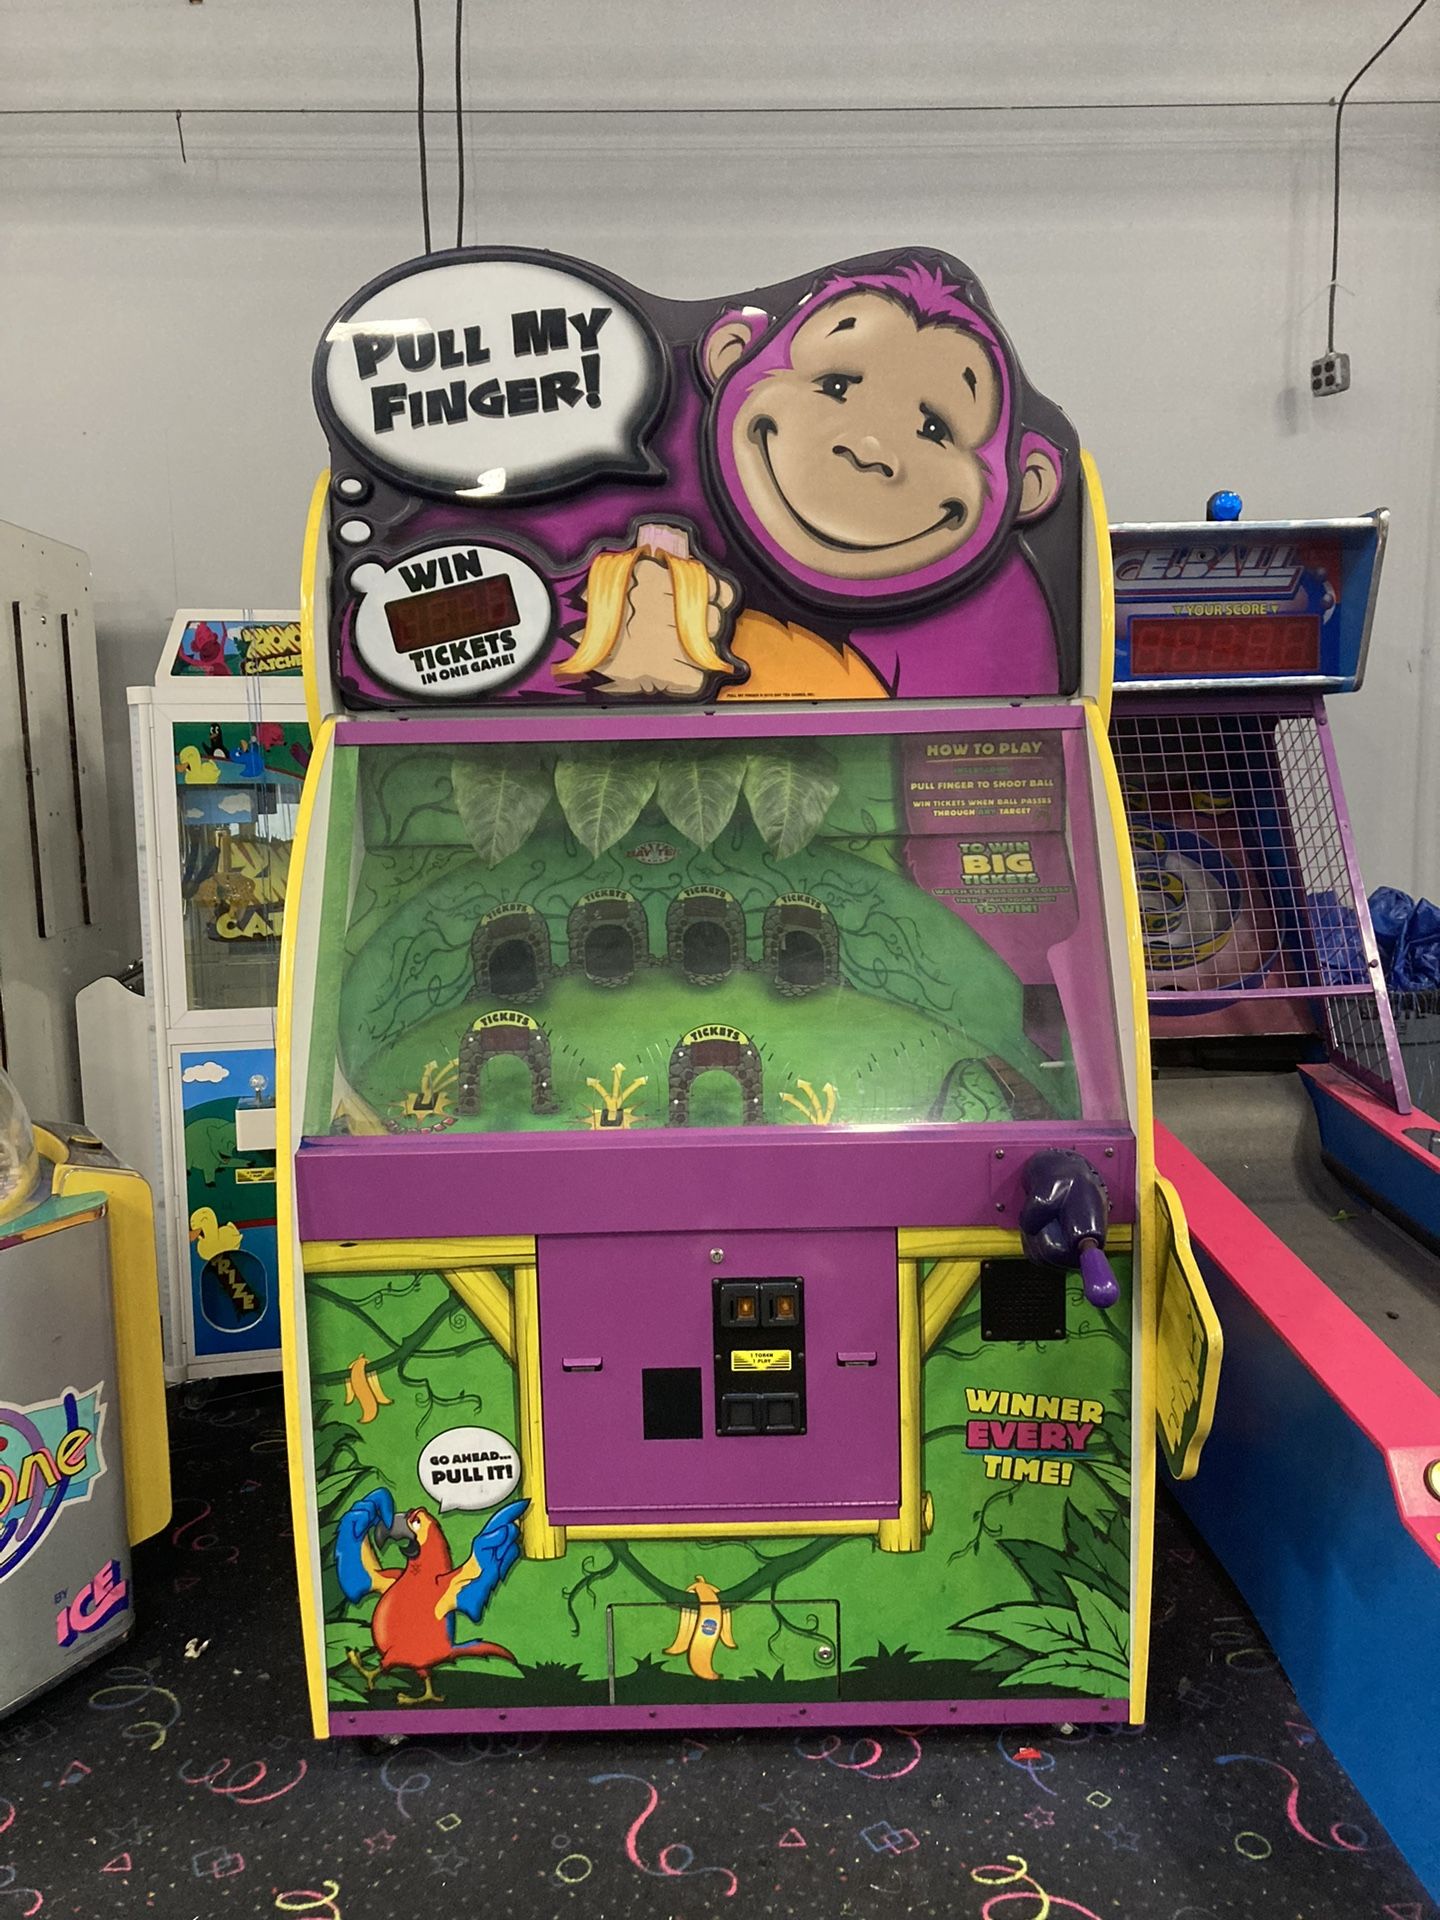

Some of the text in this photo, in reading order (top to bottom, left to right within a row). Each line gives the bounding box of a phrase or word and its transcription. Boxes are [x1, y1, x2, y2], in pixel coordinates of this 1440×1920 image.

[352, 307, 612, 380] PULL MY
[370, 354, 602, 435] FINGER!
[398, 549, 483, 593] WIN
[1113, 545, 1303, 592] CEBALL
[1186, 603, 1267, 616] YOUR SCORE
[408, 629, 517, 673] TICKETS
[244, 654, 302, 674] CATCHE
[421, 653, 516, 685] IN ONE GAME!
[926, 741, 1043, 756] HOW TO PLAY
[910, 779, 1054, 790] PULL FINGER TO SHOOT BALL
[933, 799, 966, 807] TICKETS
[958, 841, 1030, 854] TO WIN
[961, 852, 1034, 875] BIG
[961, 873, 1039, 885] TICKETS
[584, 889, 628, 902] TICKETS
[684, 885, 727, 898] TICKETS
[780, 893, 822, 909] TICKETS
[486, 903, 528, 919] TICKETS
[479, 1012, 529, 1026] TICKETS
[690, 1027, 740, 1041] TICKETS
[965, 1387, 1104, 1424] WINNER
[966, 1420, 1094, 1451] EVERY
[430, 1451, 512, 1465] GO AHEAD...
[431, 1464, 513, 1485] PULL IT!
[983, 1454, 1074, 1486] TIME!
[53, 1588, 69, 1604] BY
[55, 1558, 130, 1648] ICE
